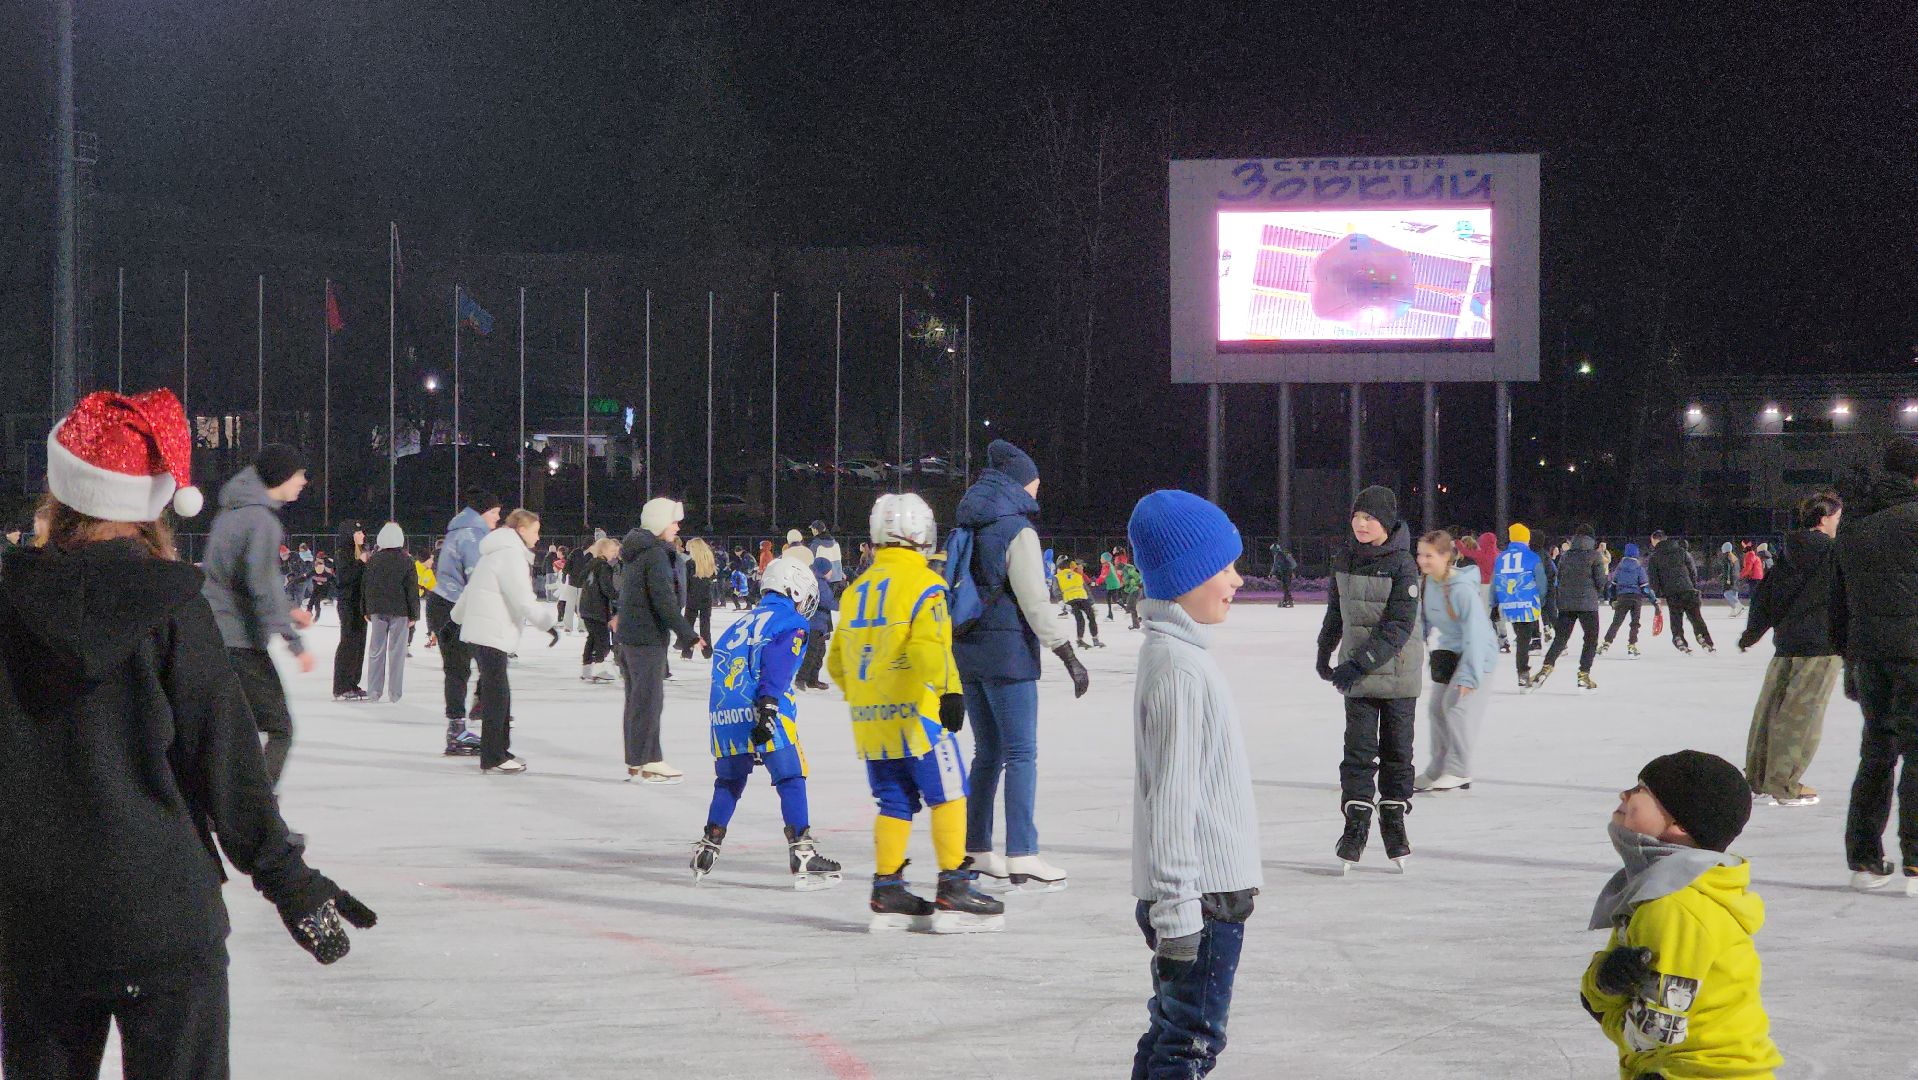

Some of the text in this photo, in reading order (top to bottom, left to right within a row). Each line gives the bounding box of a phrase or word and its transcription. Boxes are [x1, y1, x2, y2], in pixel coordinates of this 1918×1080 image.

[1501, 552, 1524, 573] 11
[850, 578, 890, 628] 11
[726, 611, 774, 650] 31
